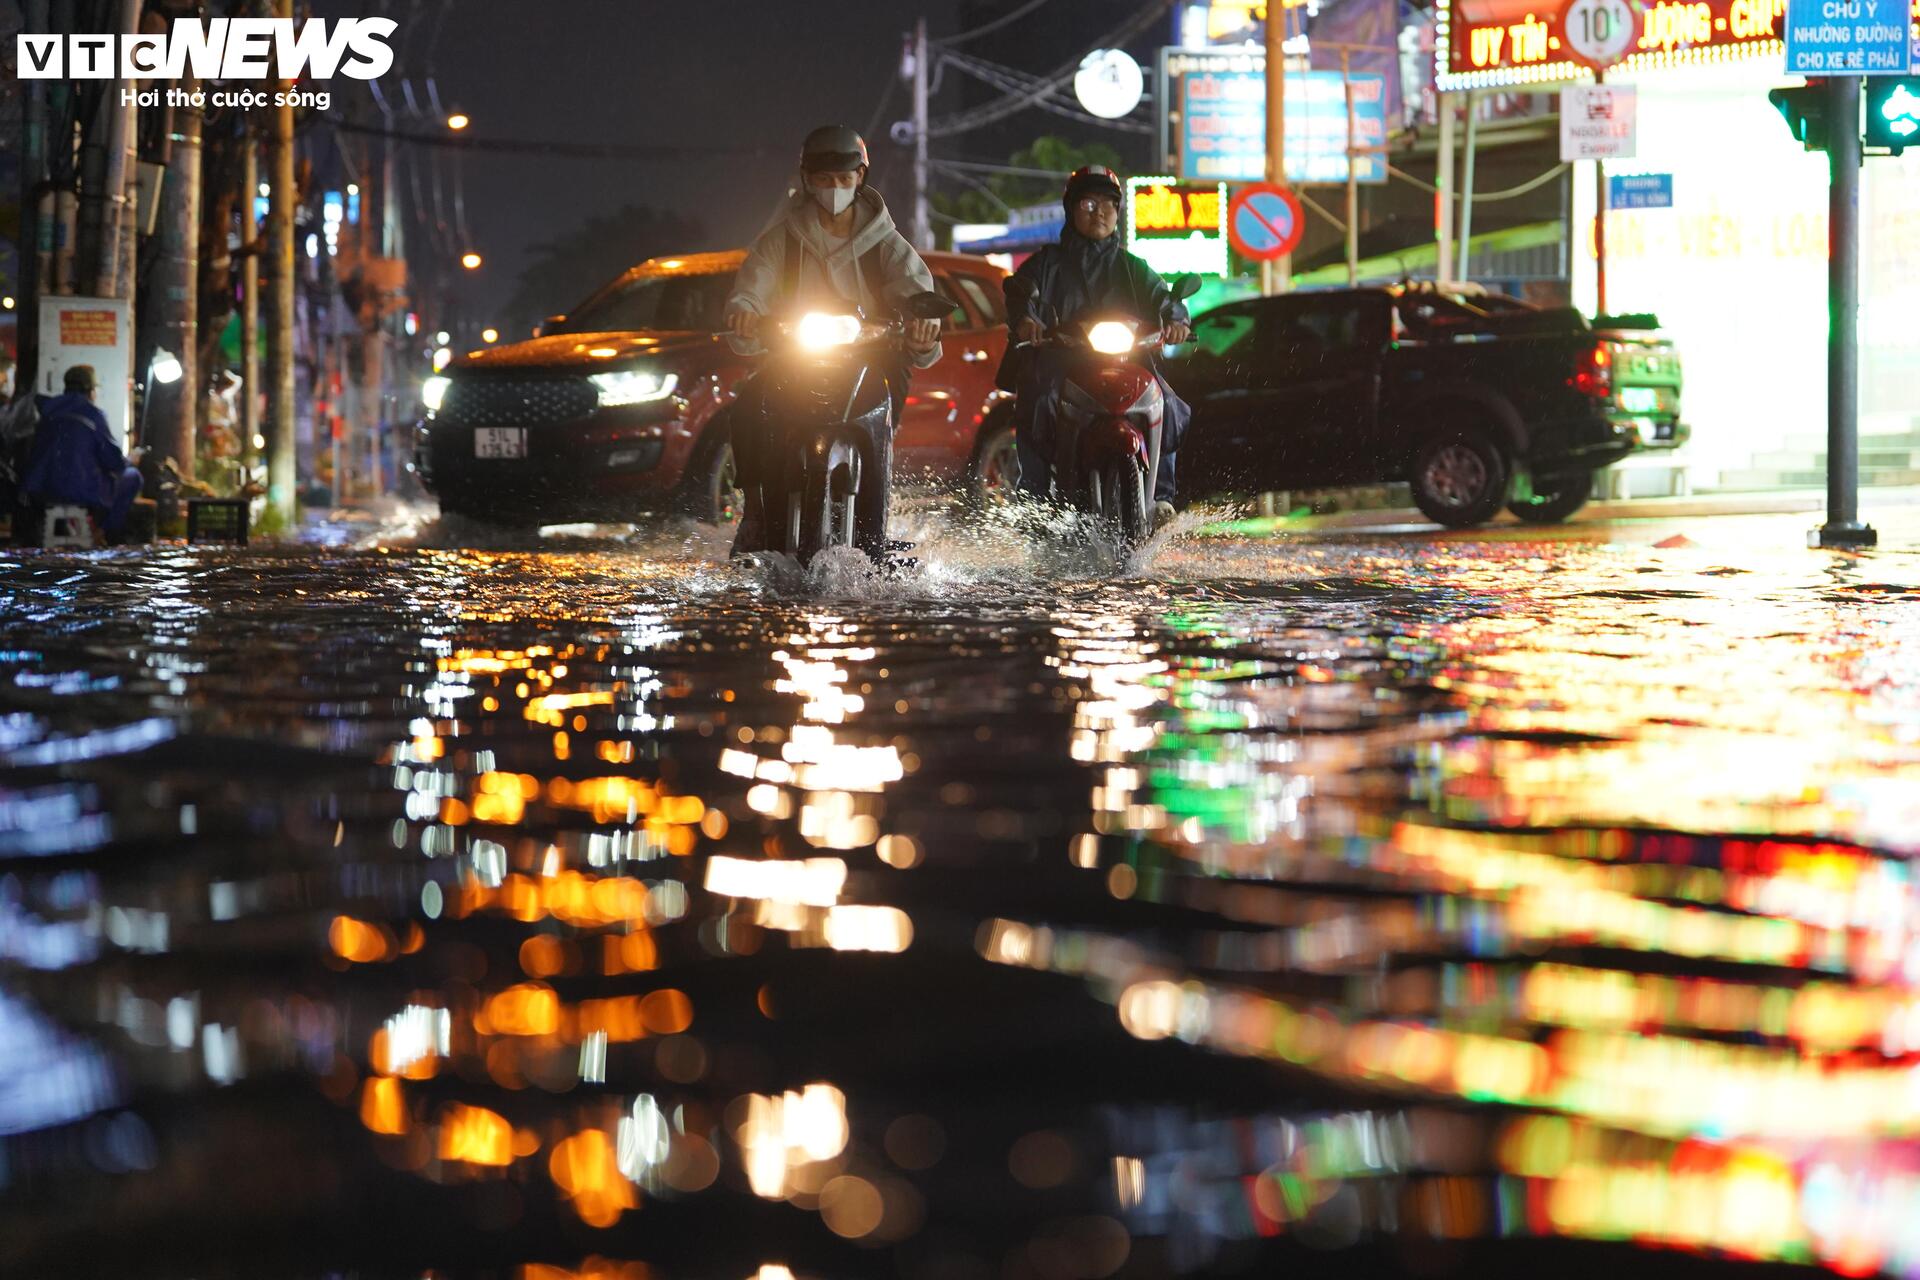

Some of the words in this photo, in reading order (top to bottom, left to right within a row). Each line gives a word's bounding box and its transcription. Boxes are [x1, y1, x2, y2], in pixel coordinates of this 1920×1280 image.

[1471, 27, 1504, 66] UY
[1508, 13, 1548, 63] TÍN
[1637, 1, 1711, 51] ƯỢNG
[1794, 22, 1851, 43] NHƯỜNG
[1855, 21, 1903, 43] ĐƯỜNG
[1797, 52, 1824, 69] CHO
[1826, 52, 1844, 69] XE
[1867, 46, 1900, 68] PHẢI
